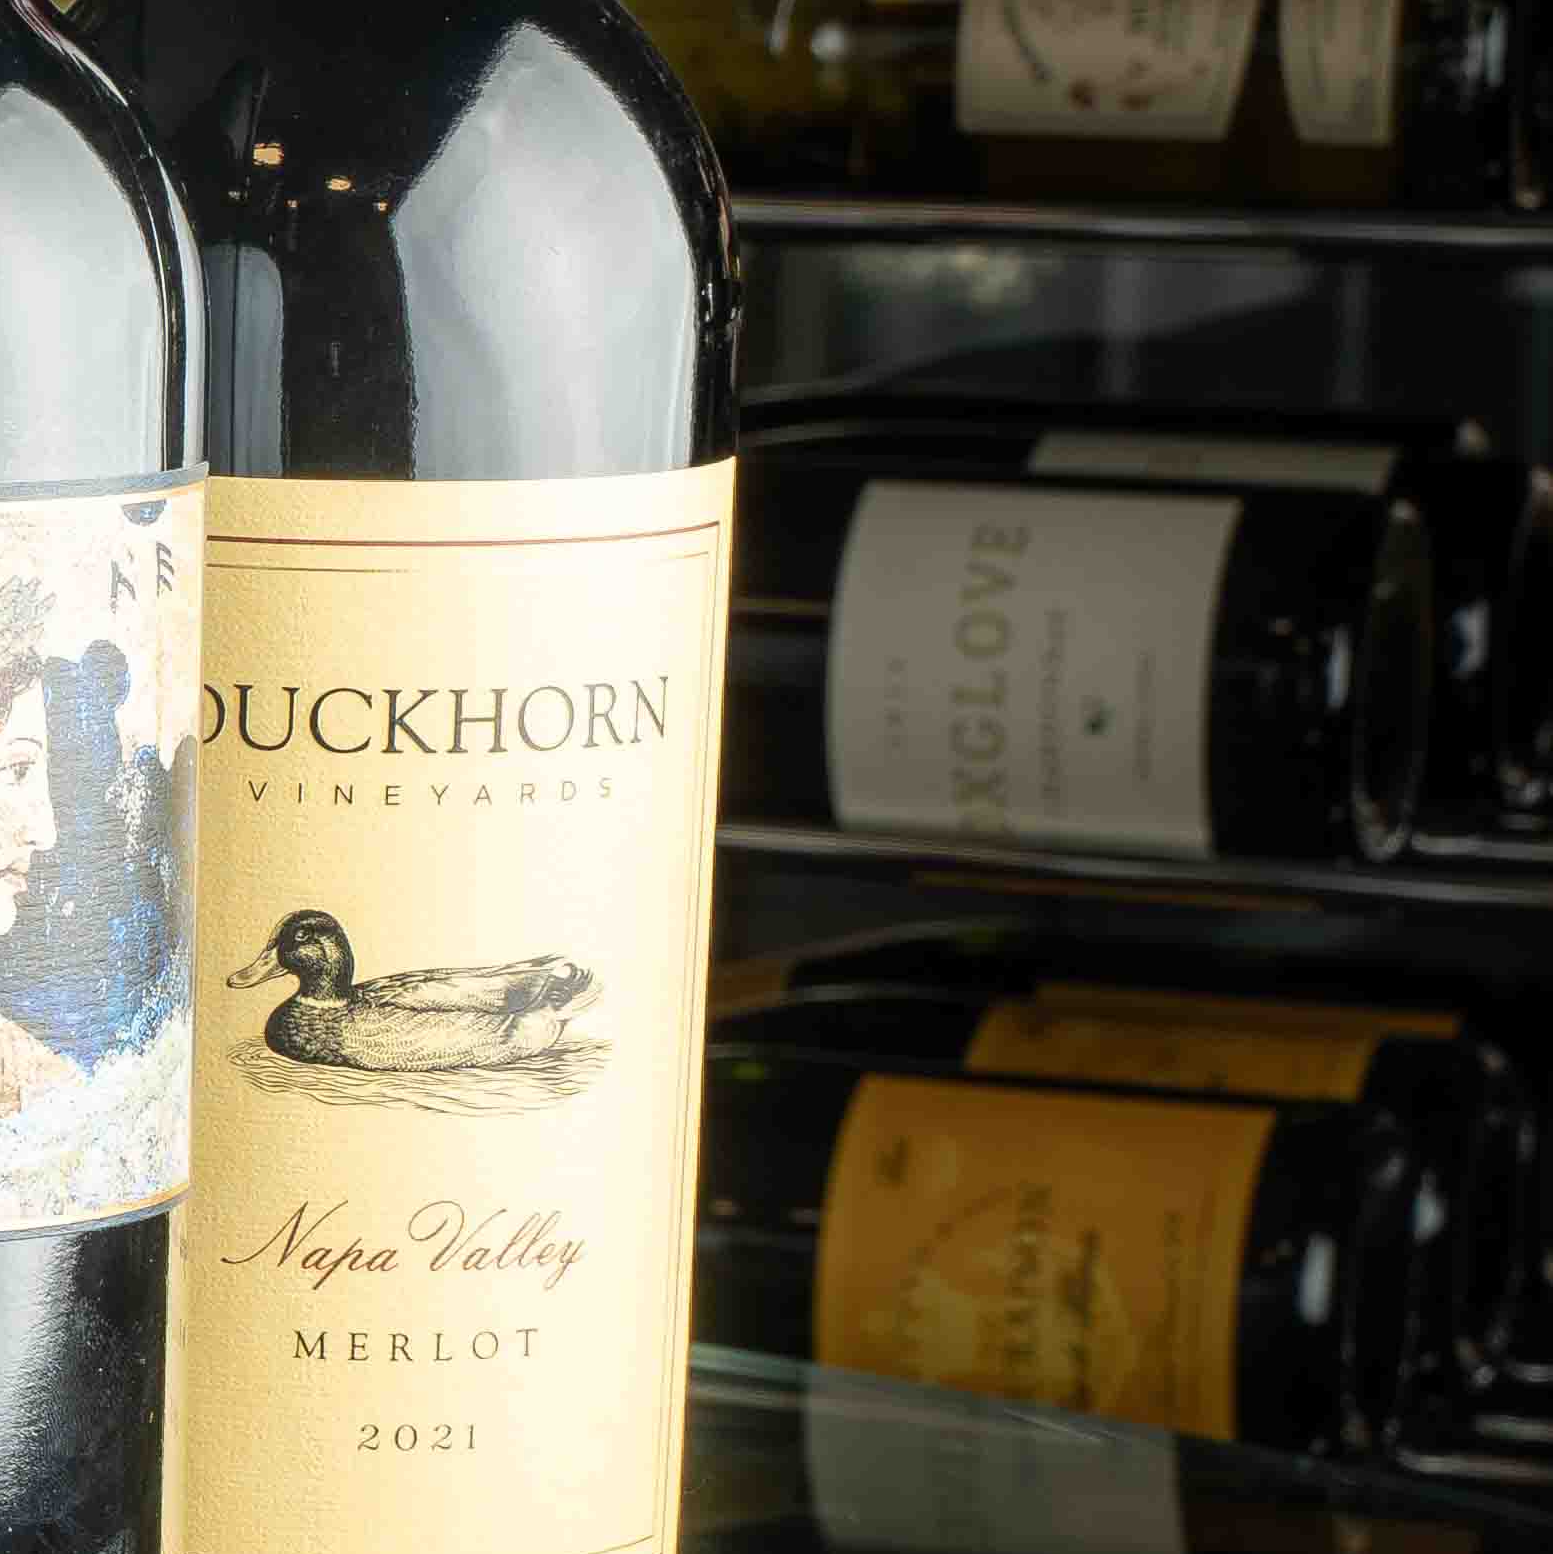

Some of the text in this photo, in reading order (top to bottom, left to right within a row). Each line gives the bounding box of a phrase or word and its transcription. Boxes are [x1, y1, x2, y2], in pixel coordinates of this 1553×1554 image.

[249, 776, 612, 807] VINEYARDS
[221, 1199, 587, 1291] Napa Valley
[291, 1327, 539, 1362] MERLOT
[356, 1423, 477, 1452] 2021
